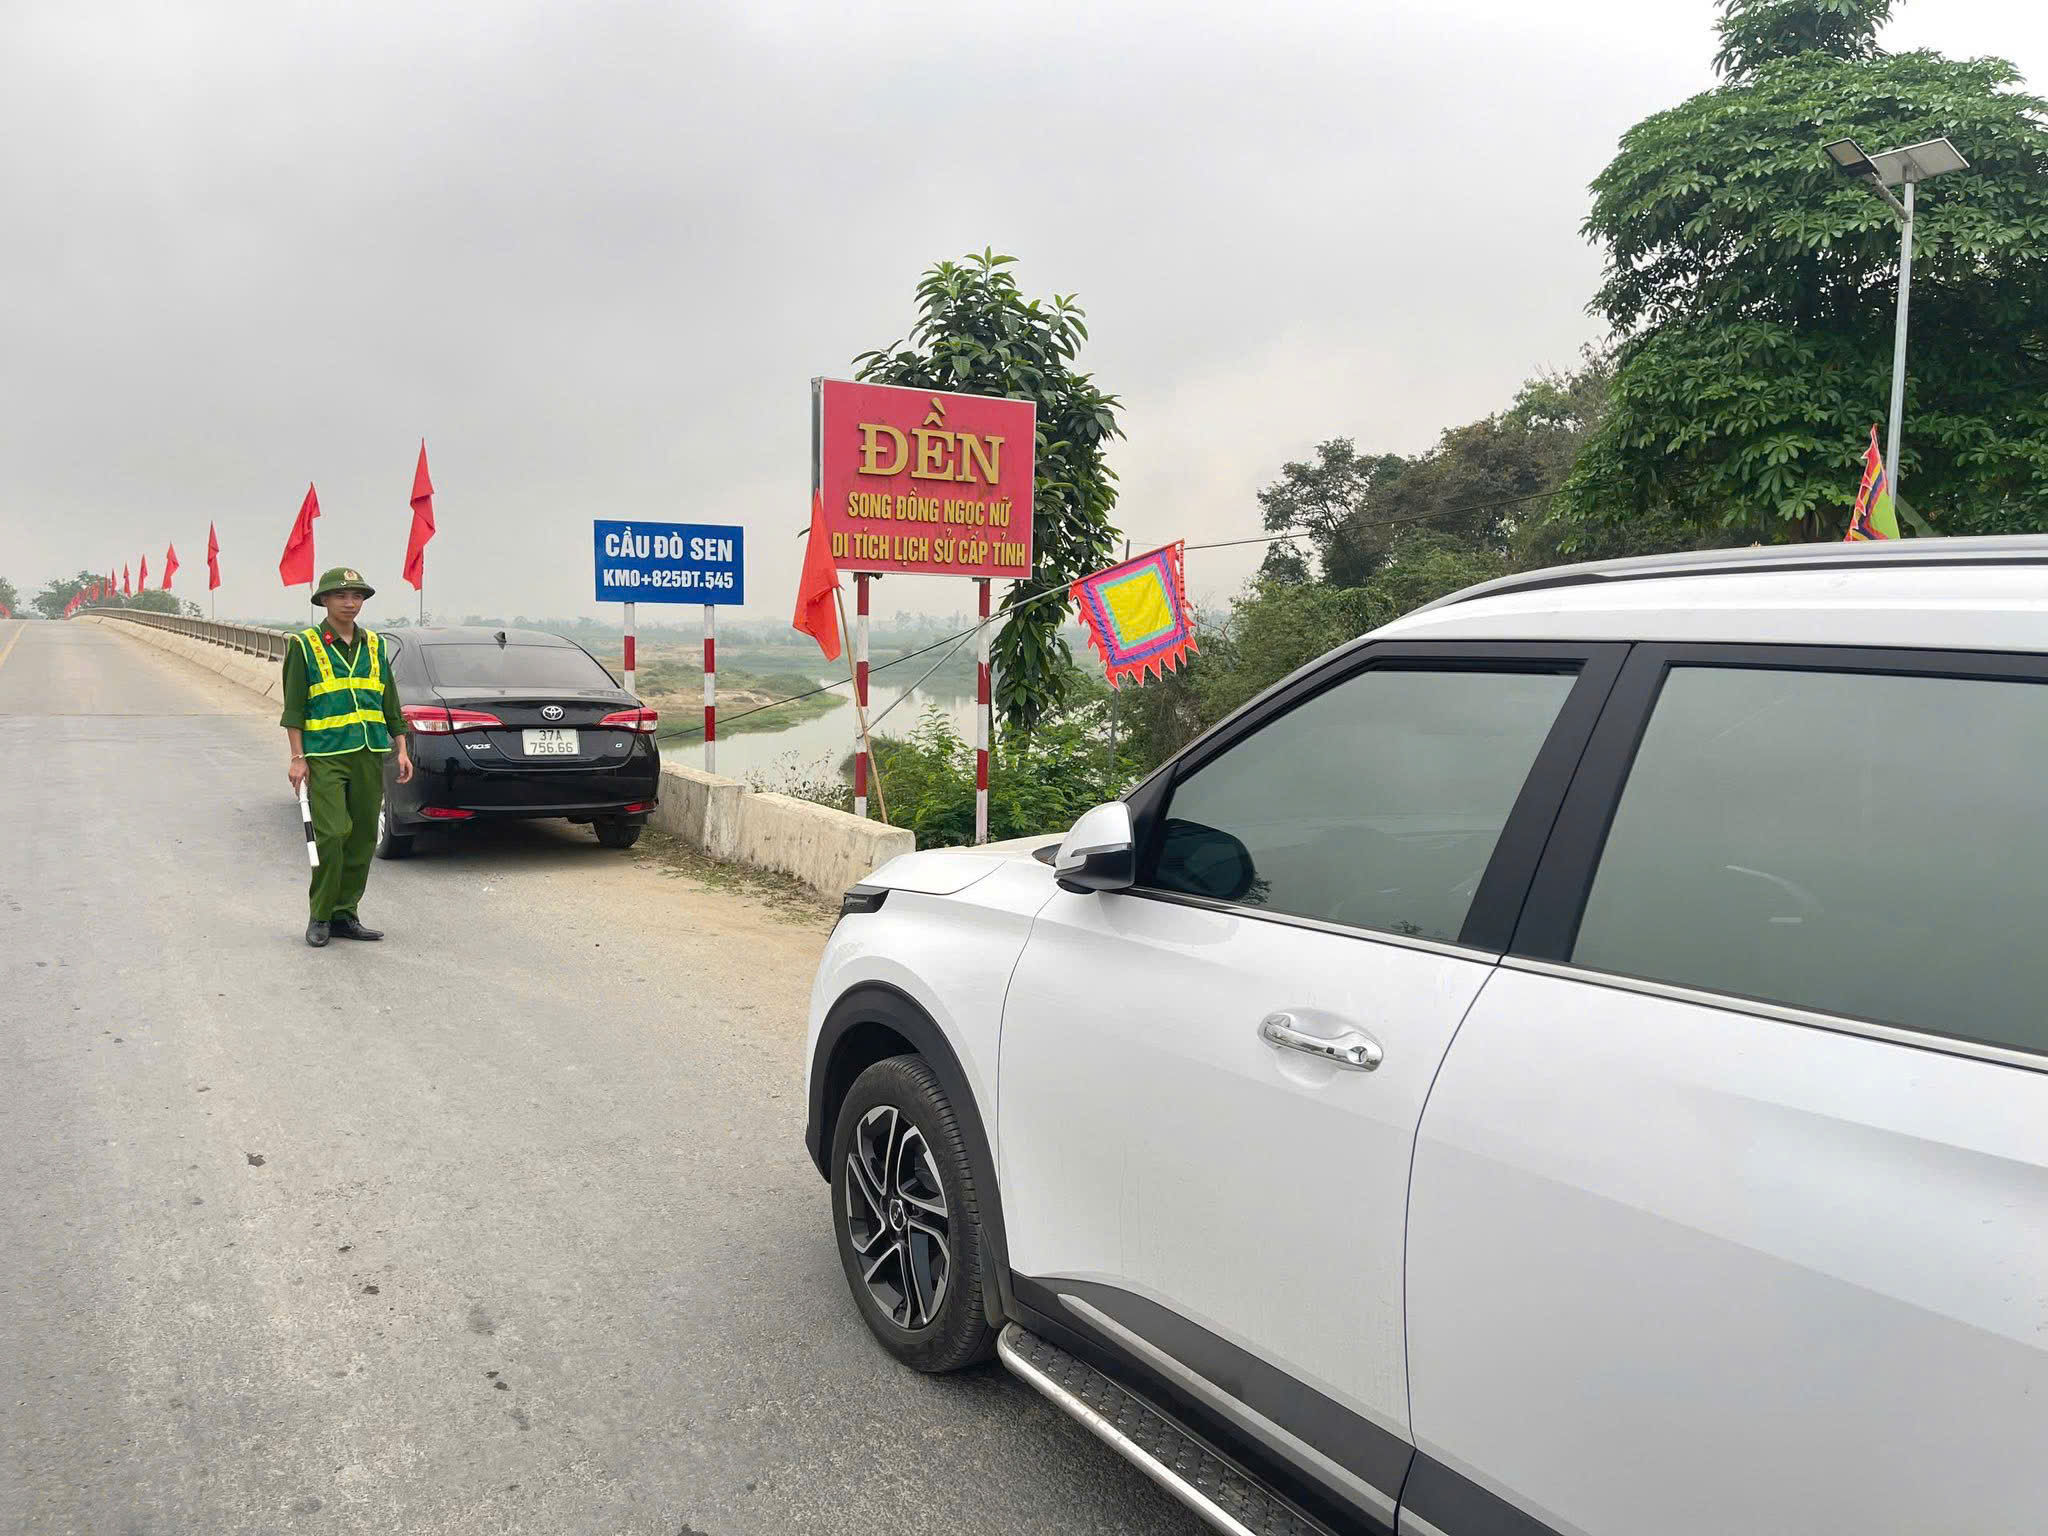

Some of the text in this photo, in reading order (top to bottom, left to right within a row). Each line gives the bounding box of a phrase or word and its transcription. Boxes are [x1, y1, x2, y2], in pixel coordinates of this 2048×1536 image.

[858, 397, 1005, 484] ĐỀN
[848, 487, 1012, 530] SONG ĐỒNG NGỌC NỮ
[605, 526, 733, 562] CẦU ĐÒ SEN
[832, 526, 1025, 567] DI TÍCH LỊCH SỬ CẤP TỈNH
[530, 742, 573, 753] 756.66
[539, 730, 562, 741] 37A
